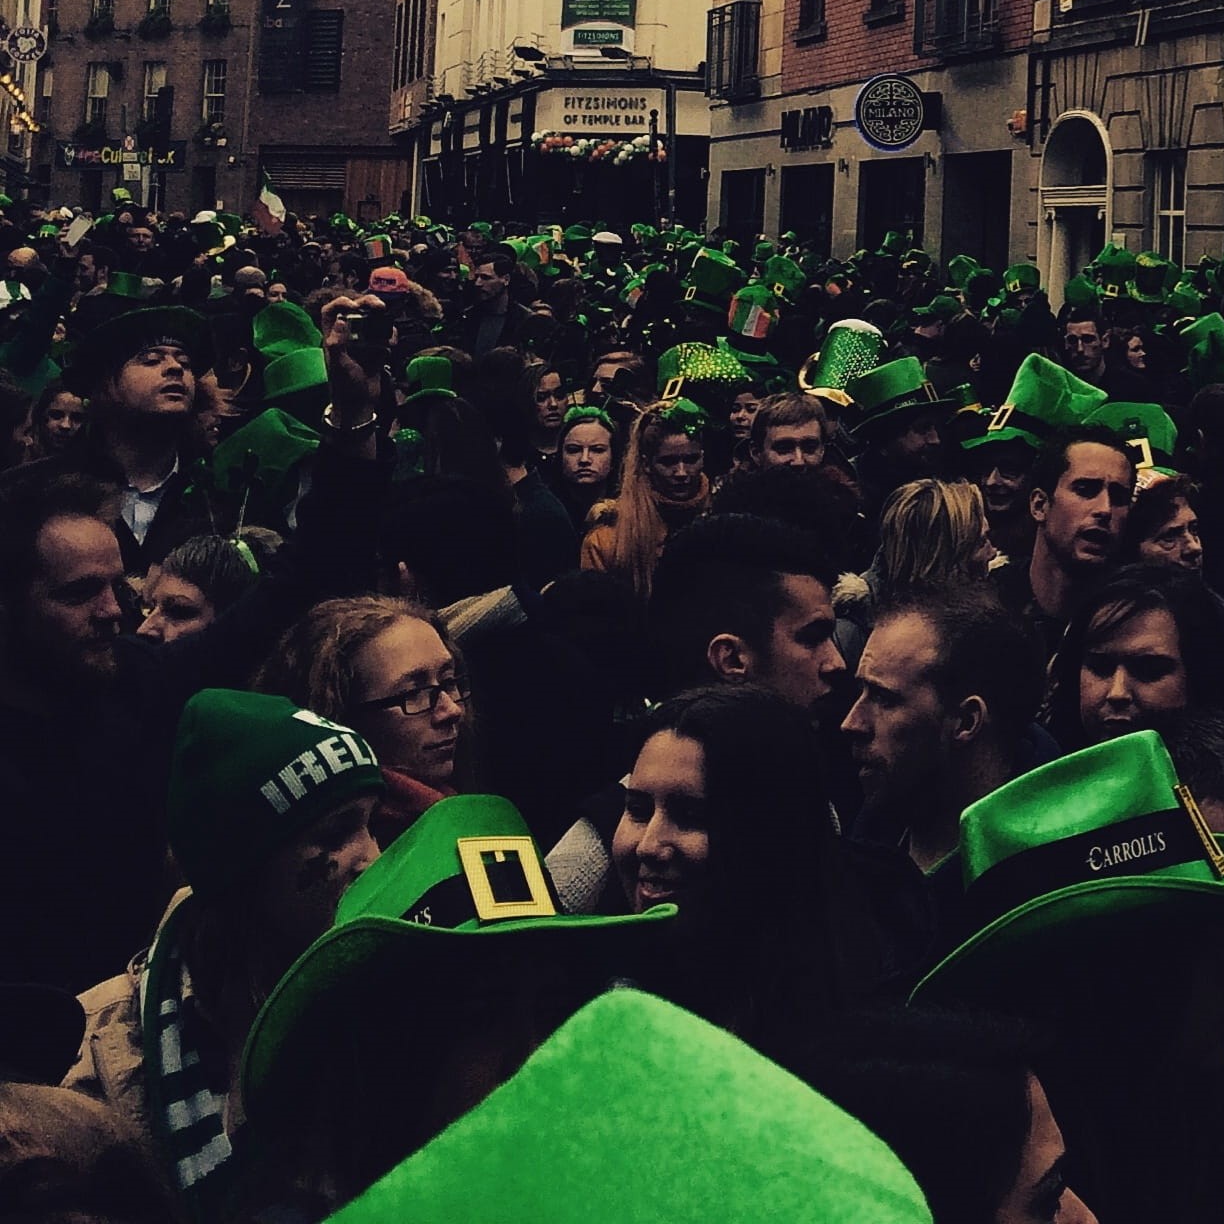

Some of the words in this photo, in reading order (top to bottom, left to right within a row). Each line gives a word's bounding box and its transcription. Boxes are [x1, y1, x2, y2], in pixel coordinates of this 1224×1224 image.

[14, 28, 40, 38] COSTA
[10, 47, 42, 59] COFFEE
[563, 96, 648, 111] FITZSIMONS
[868, 107, 915, 119] MILANO
[563, 114, 579, 126] OF
[581, 114, 621, 126] TEMPLE
[624, 114, 645, 126] BAR
[259, 733, 379, 815] IREL
[1085, 831, 1167, 871] CARROLL'S
